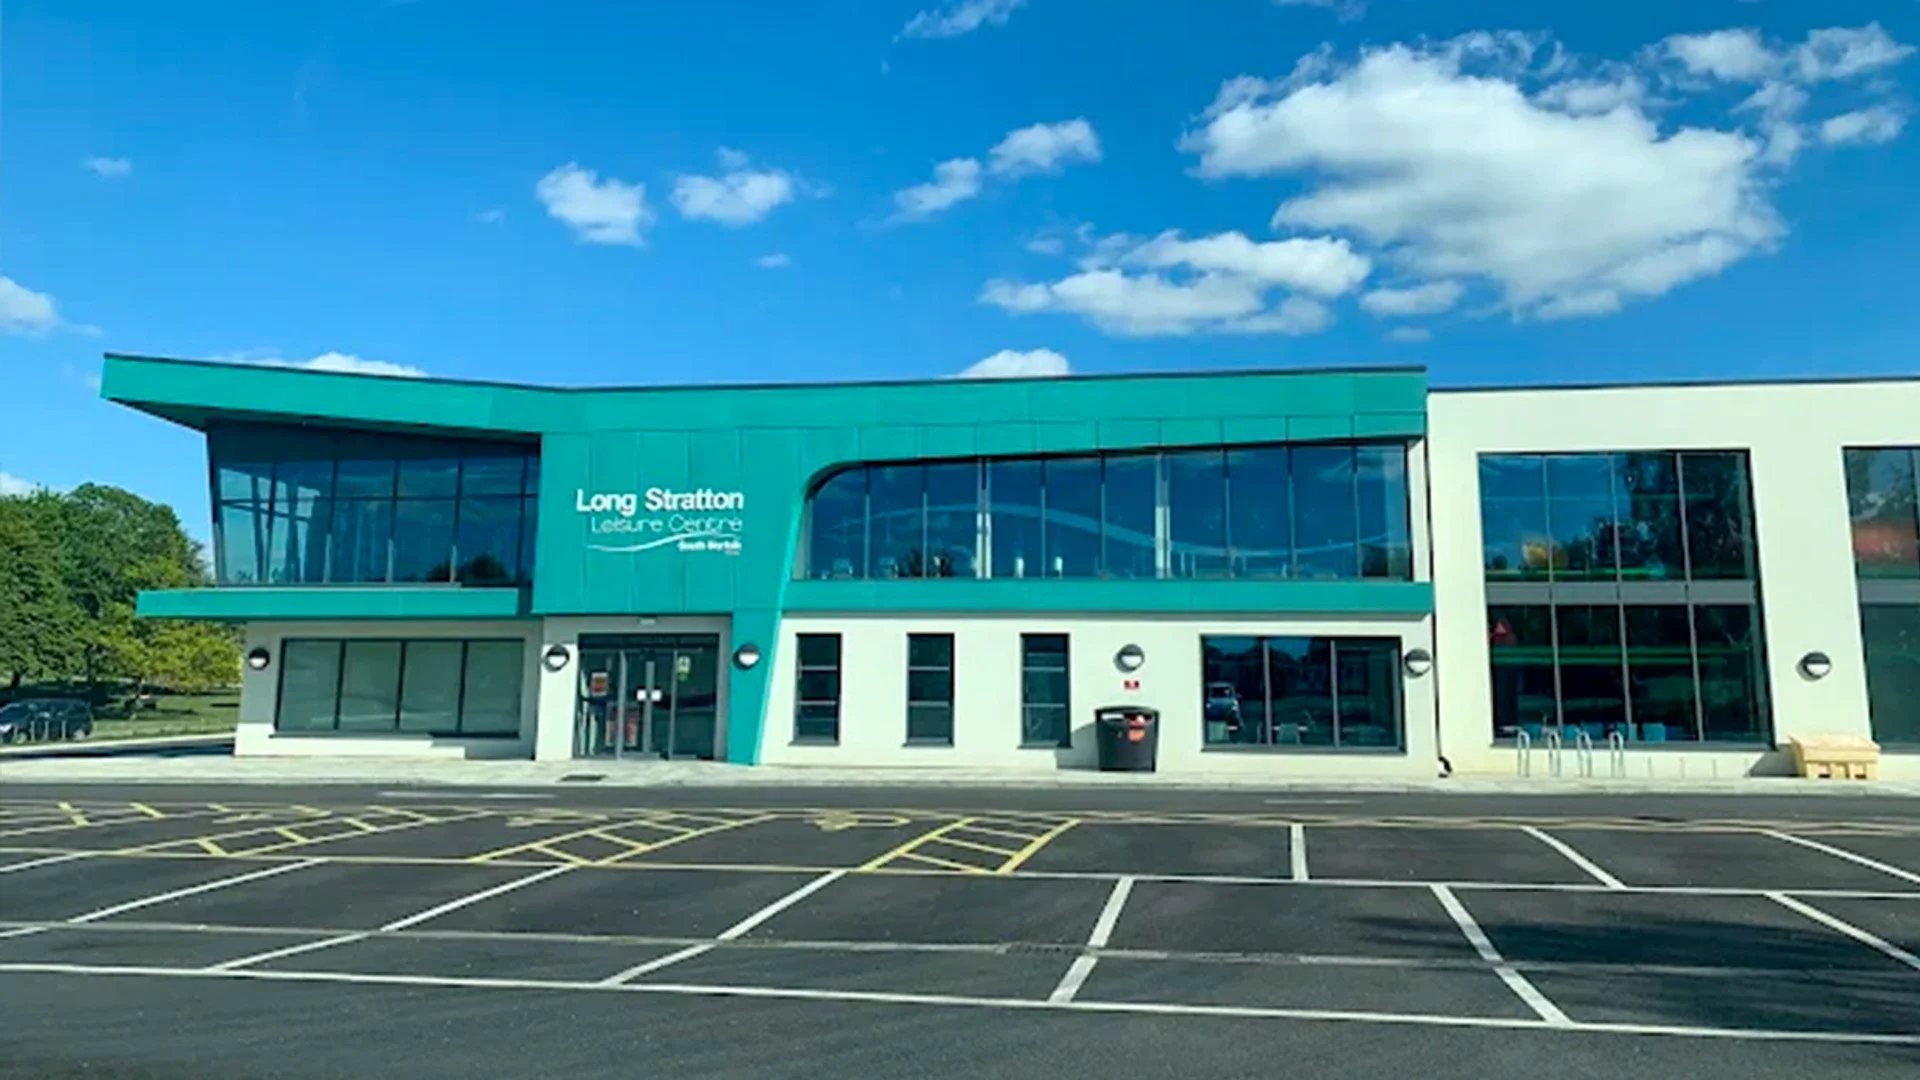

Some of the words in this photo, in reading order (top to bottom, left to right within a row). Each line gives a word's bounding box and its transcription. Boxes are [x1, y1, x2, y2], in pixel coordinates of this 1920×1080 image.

[576, 488, 637, 517] Long
[645, 487, 744, 511] Stratton
[591, 516, 663, 533] Leisure
[668, 514, 742, 532] Centre
